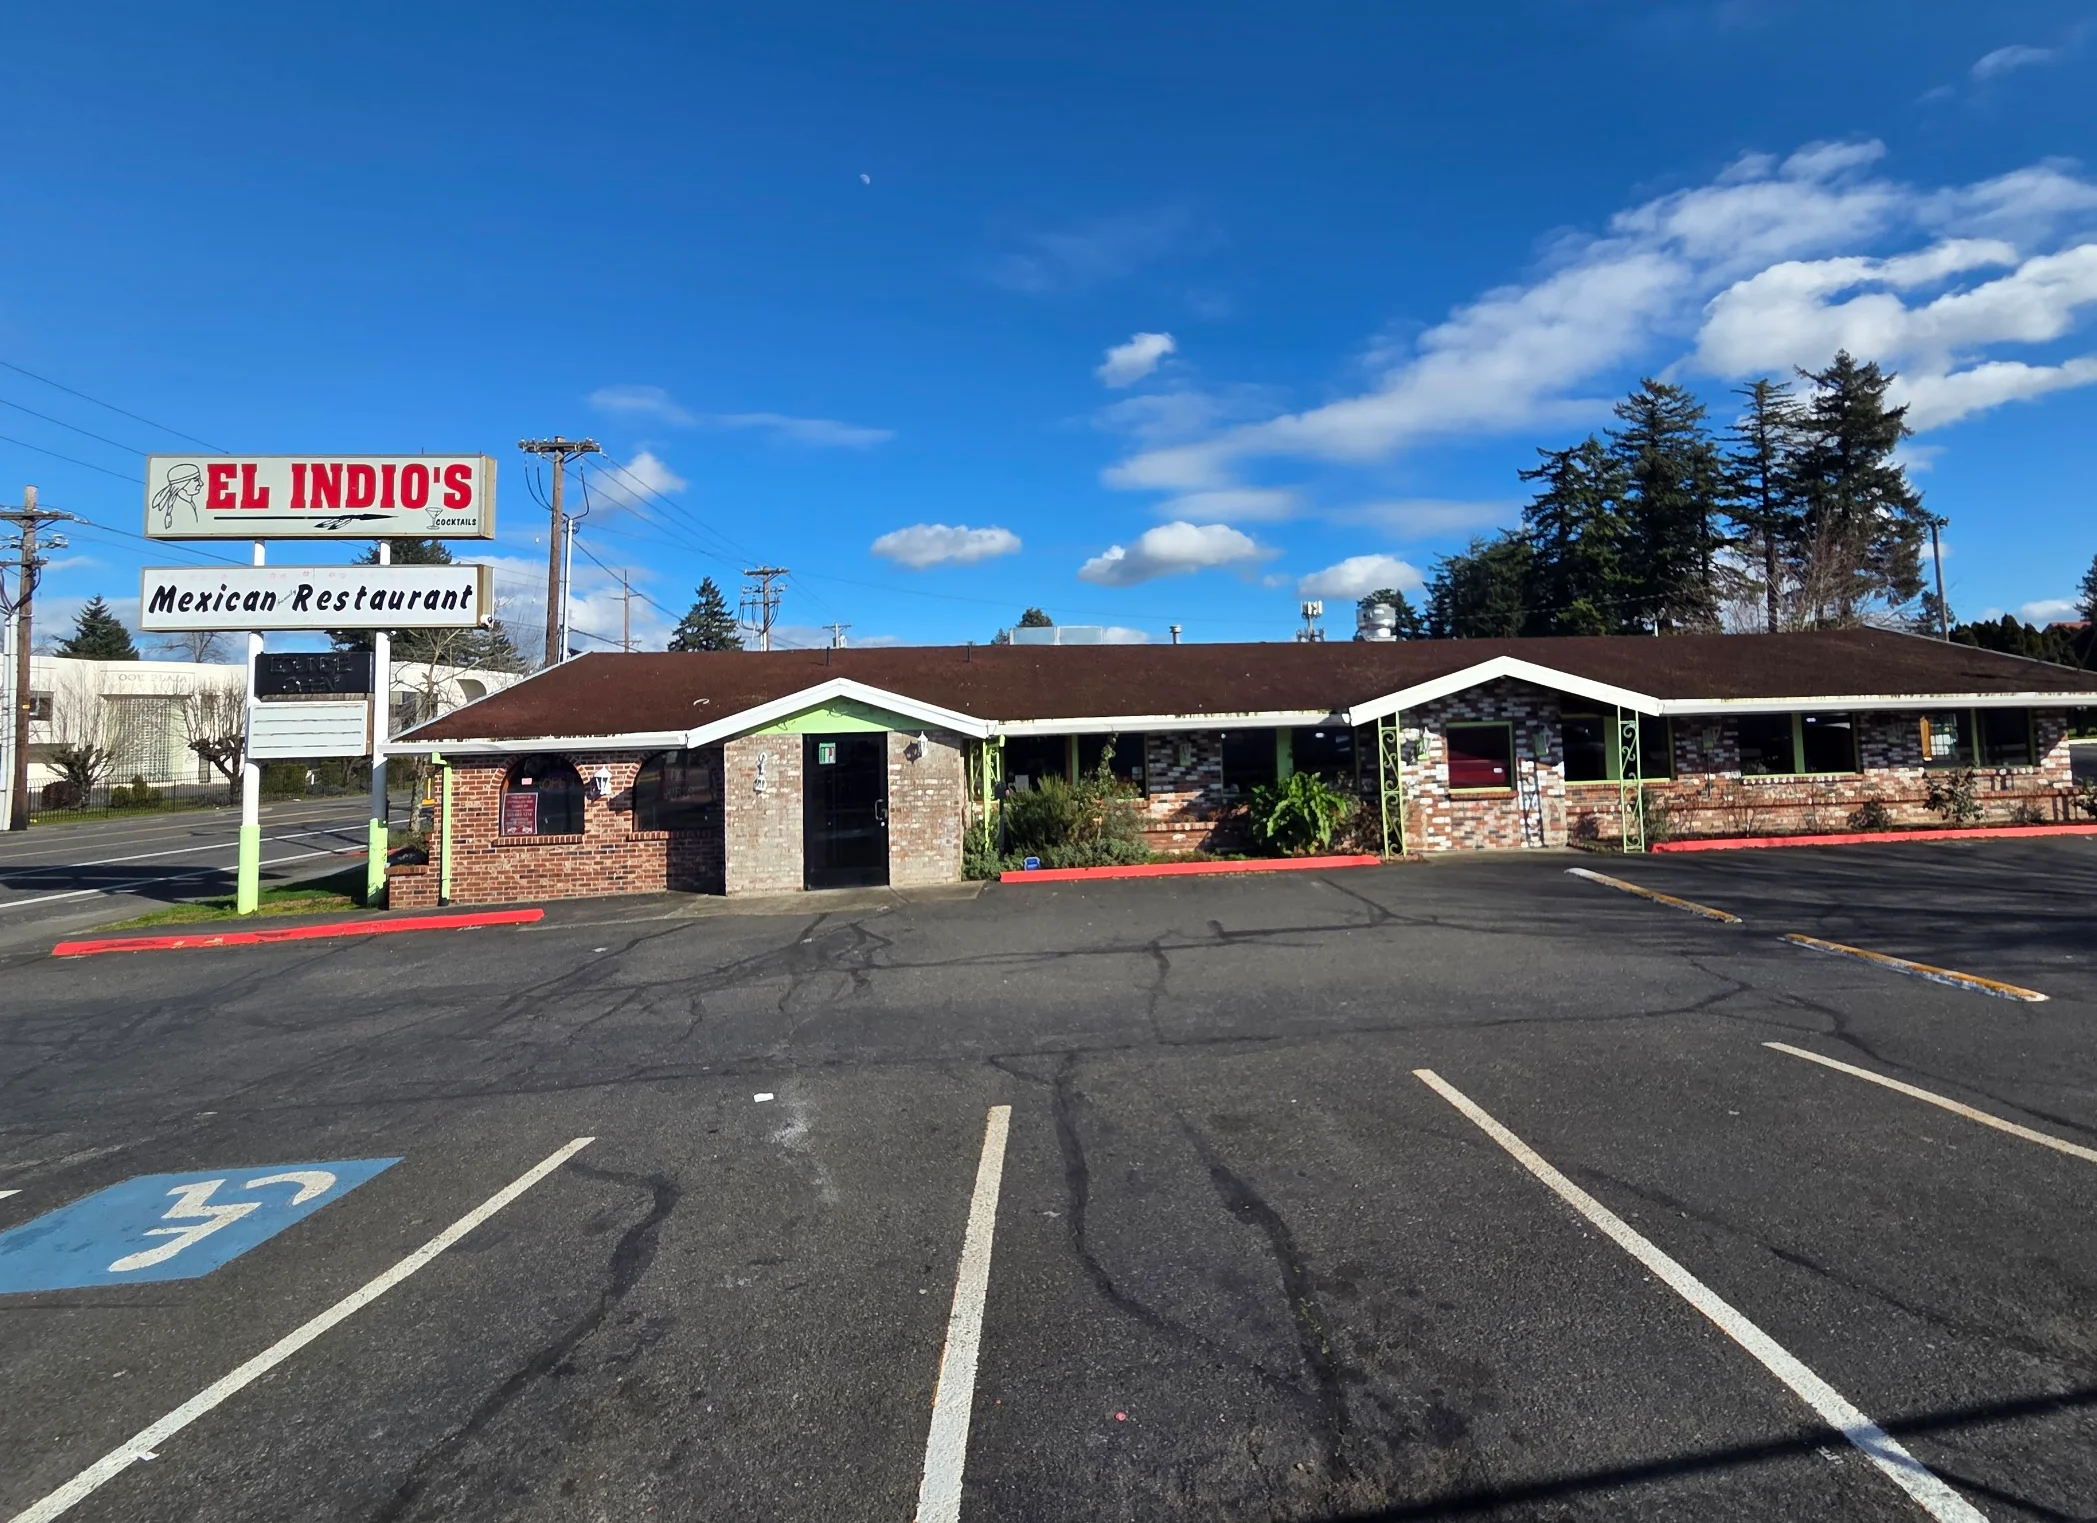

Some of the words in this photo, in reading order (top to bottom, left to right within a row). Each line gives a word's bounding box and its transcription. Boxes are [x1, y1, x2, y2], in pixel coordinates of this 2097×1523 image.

[205, 463, 270, 510] EL
[290, 463, 474, 510] INDIO'S
[435, 518, 477, 526] COCKTAILS
[148, 583, 277, 613] Mexican
[291, 583, 473, 613] Restaurant
